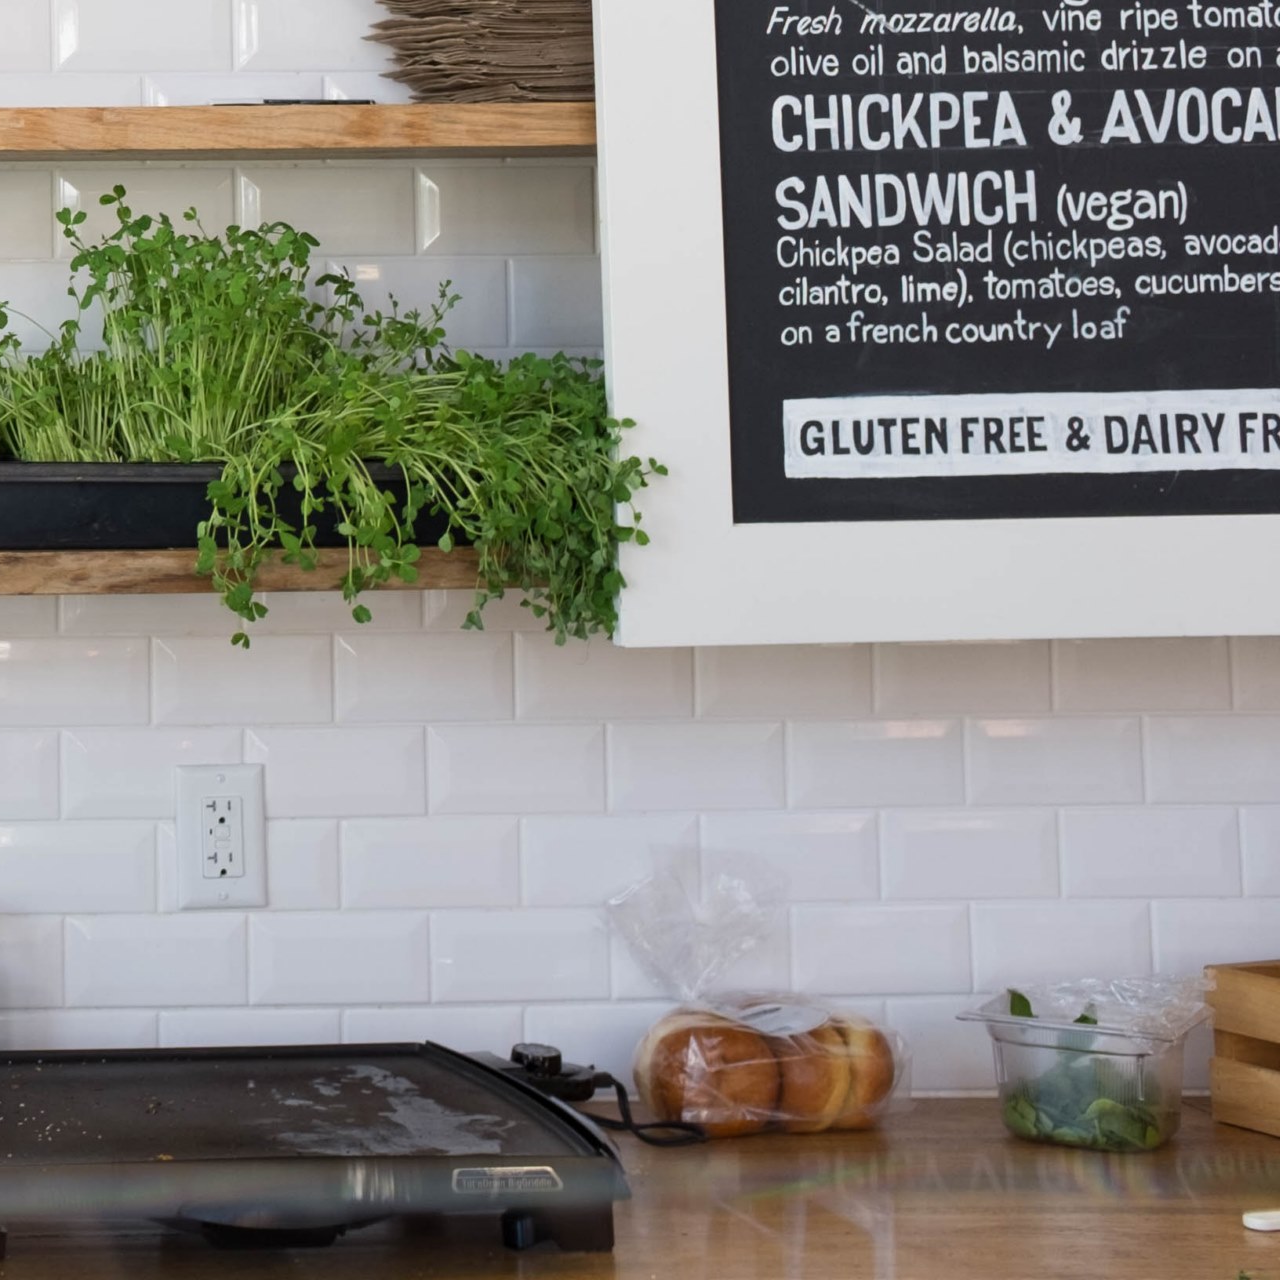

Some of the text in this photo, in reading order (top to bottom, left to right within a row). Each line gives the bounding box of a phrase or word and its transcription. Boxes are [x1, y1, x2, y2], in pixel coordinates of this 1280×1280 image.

[772, 90, 1083, 152] CHICKPEA &
[776, 170, 1187, 231] SANDWICH (vegan)
[800, 413, 1225, 456] GLUTEN FREE & DAIRY
